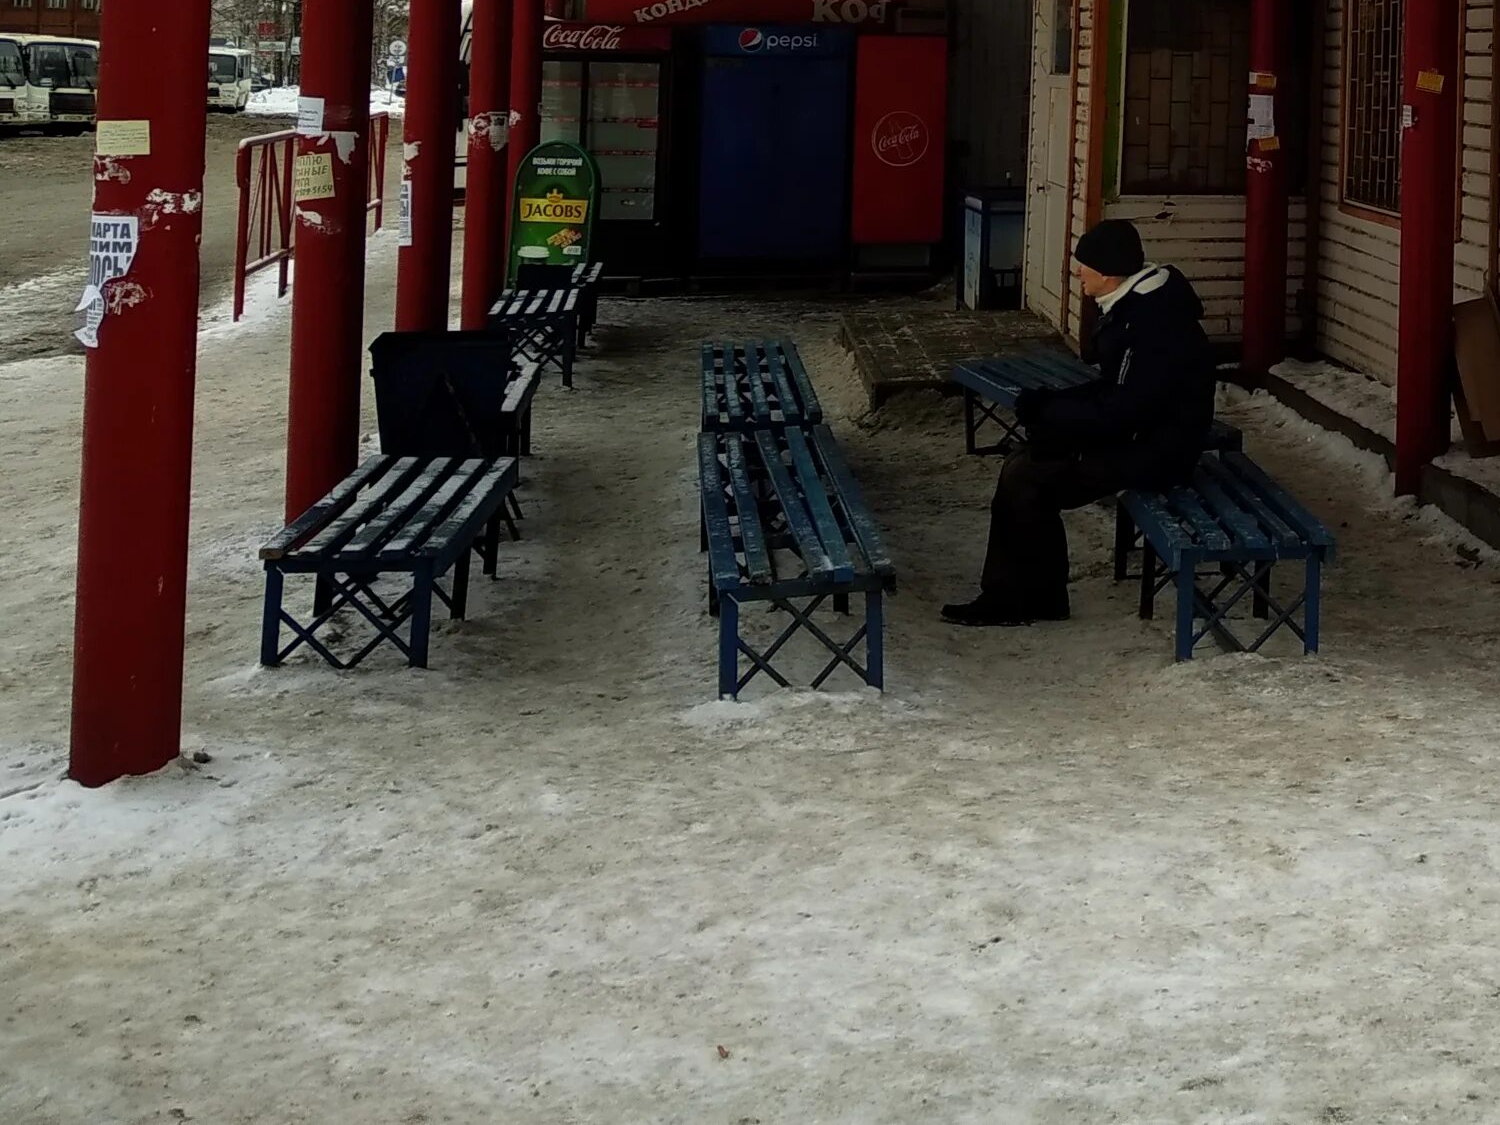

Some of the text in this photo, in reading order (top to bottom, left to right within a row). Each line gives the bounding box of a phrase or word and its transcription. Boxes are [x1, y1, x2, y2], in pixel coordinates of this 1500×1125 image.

[766, 32, 817, 51] pepsi
[523, 203, 582, 219] JACOBS
[92, 222, 131, 239] АРТА
